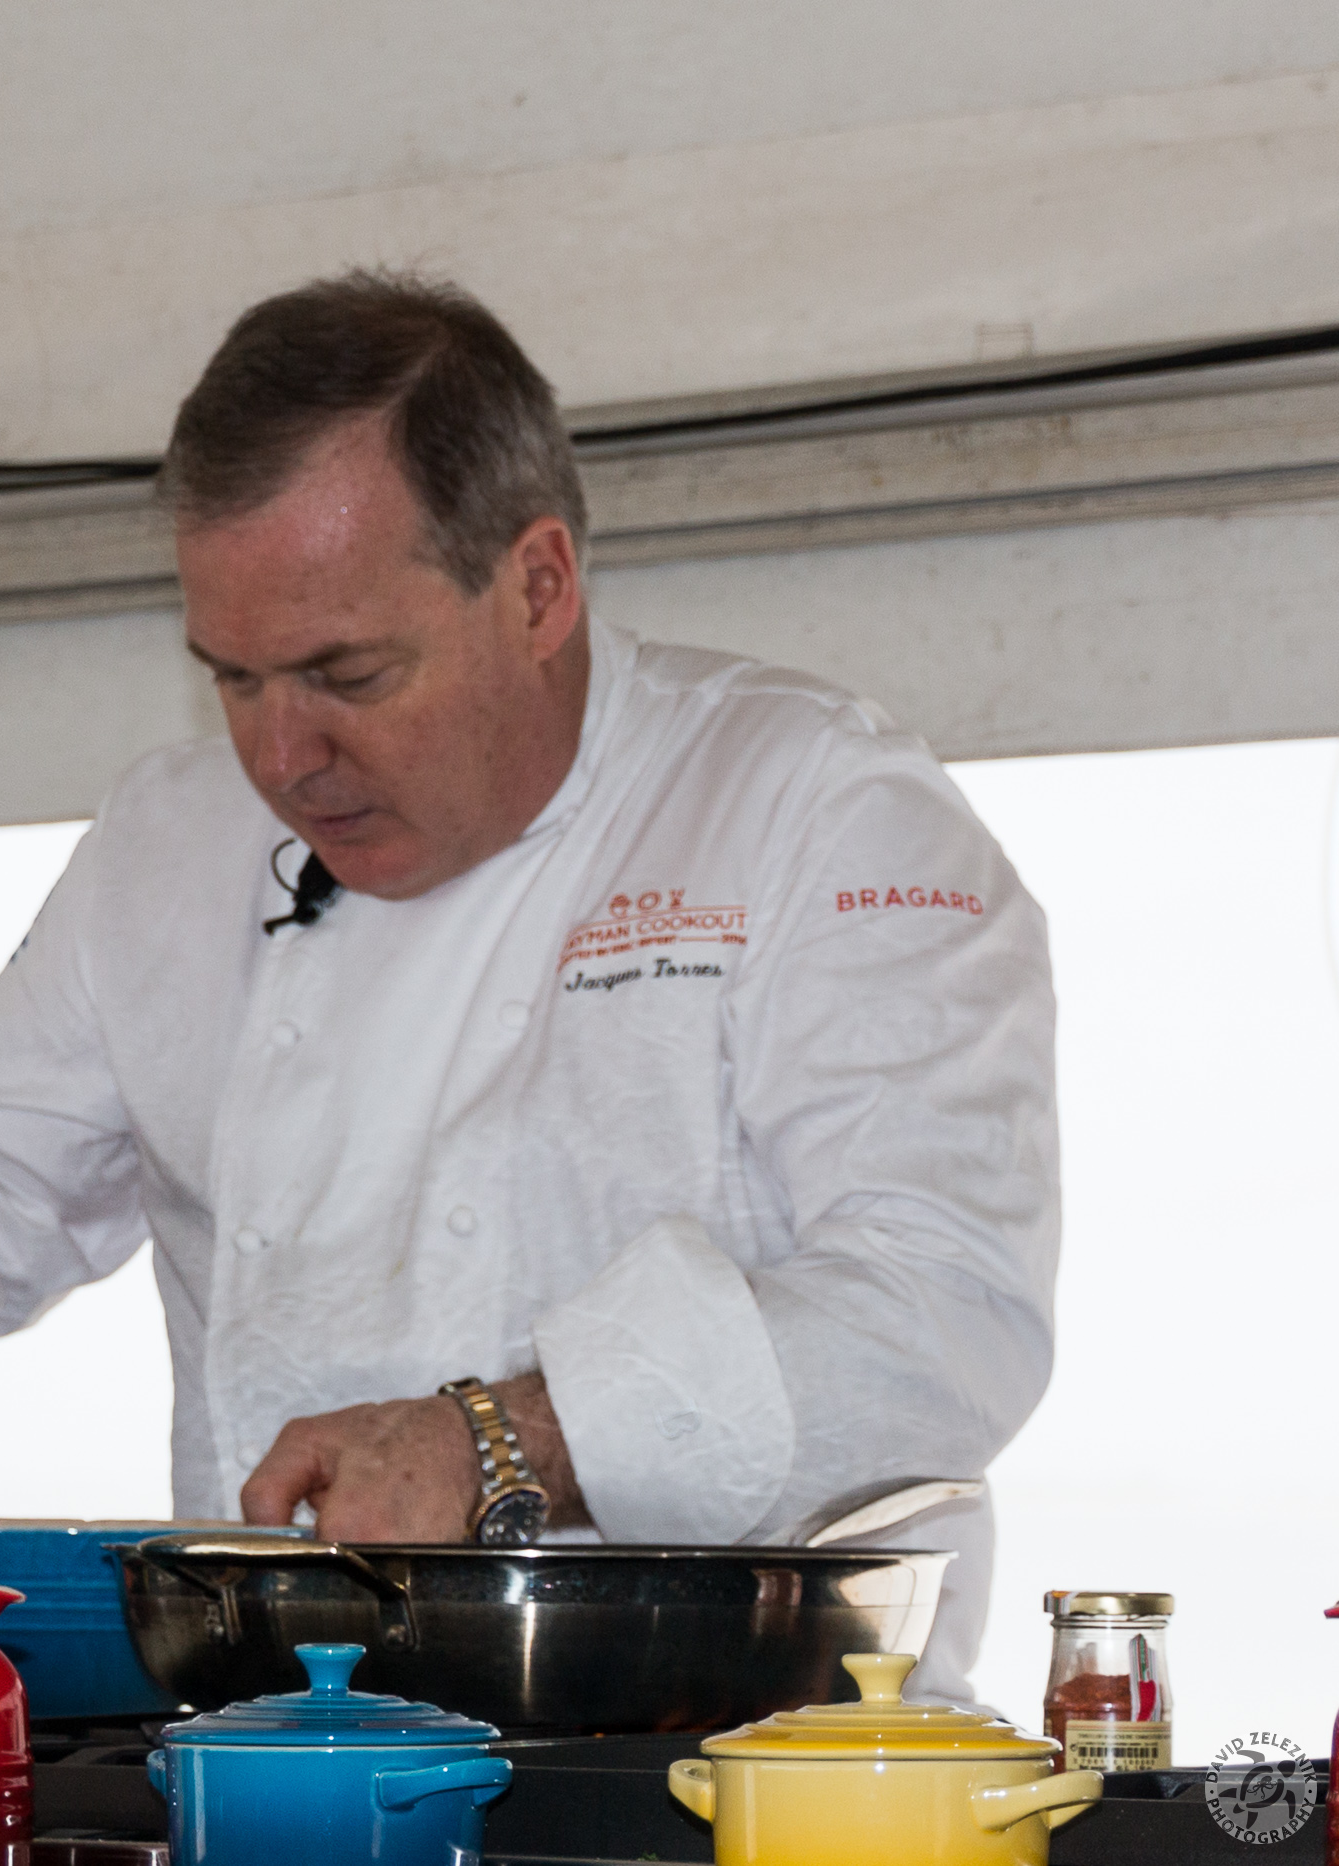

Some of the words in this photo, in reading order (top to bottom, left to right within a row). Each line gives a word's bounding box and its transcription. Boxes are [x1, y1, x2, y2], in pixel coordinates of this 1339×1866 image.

[836, 884, 984, 915] BRAGARD
[636, 912, 748, 935] COOKOUT
[564, 967, 643, 993] Jacques
[653, 956, 724, 979] Torres
